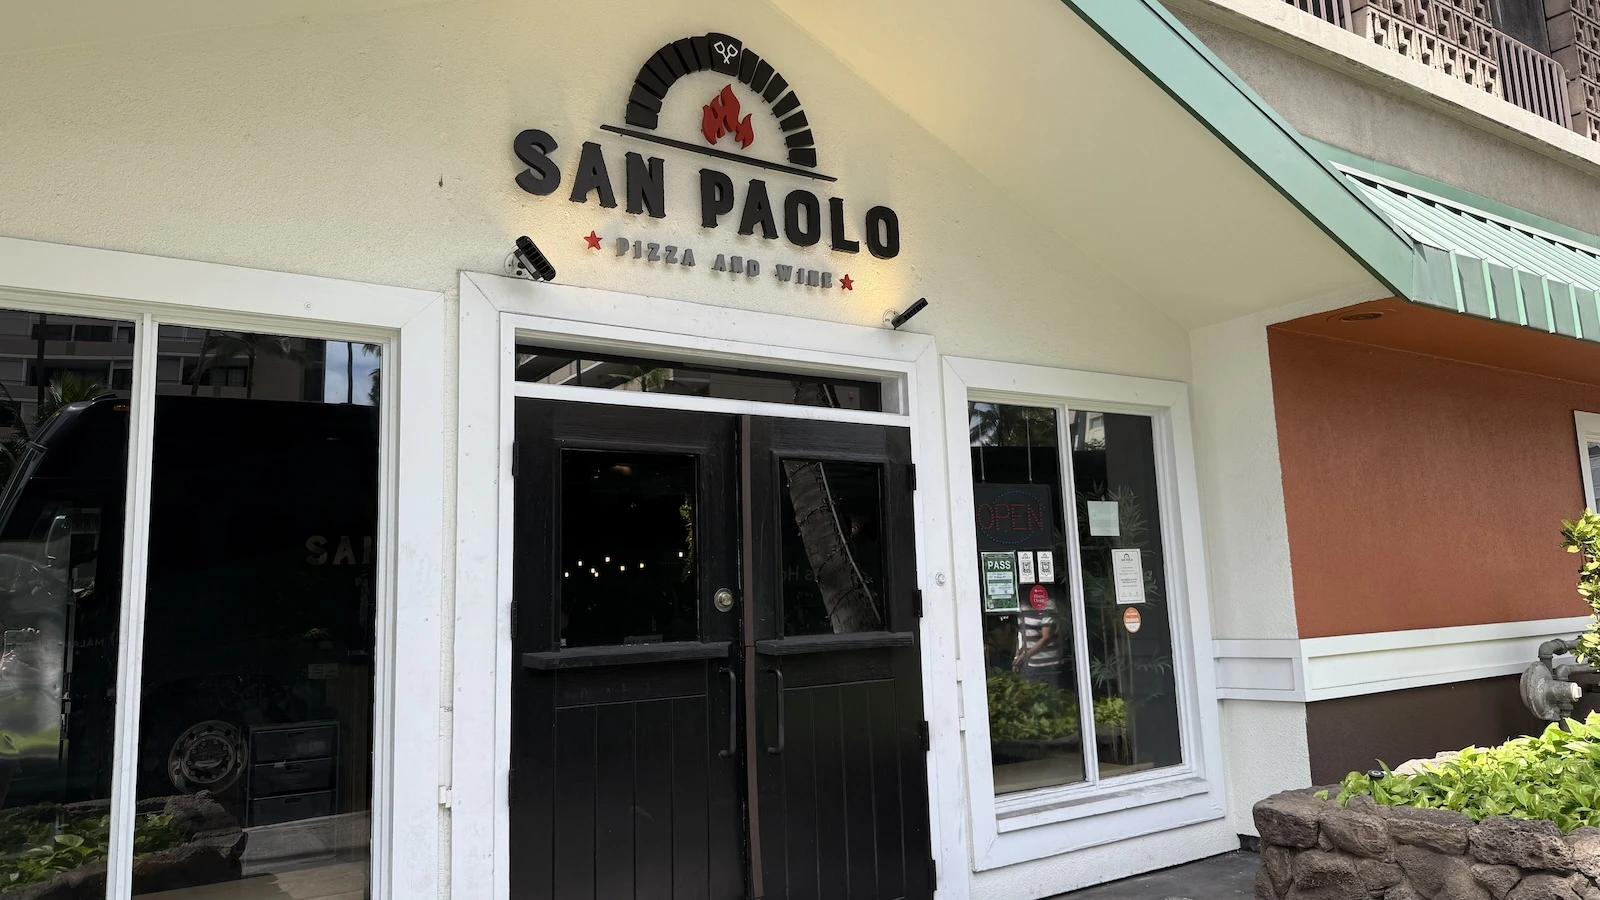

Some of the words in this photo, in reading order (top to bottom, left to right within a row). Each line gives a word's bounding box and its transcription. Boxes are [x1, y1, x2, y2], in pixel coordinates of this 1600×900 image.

[513, 128, 666, 219] SAN
[699, 168, 901, 259] PAOLO
[616, 237, 696, 267] PIZZA
[712, 254, 761, 277] AND
[776, 264, 834, 289] WINE
[977, 503, 1044, 531] OPEN
[987, 561, 1011, 570] PASS
